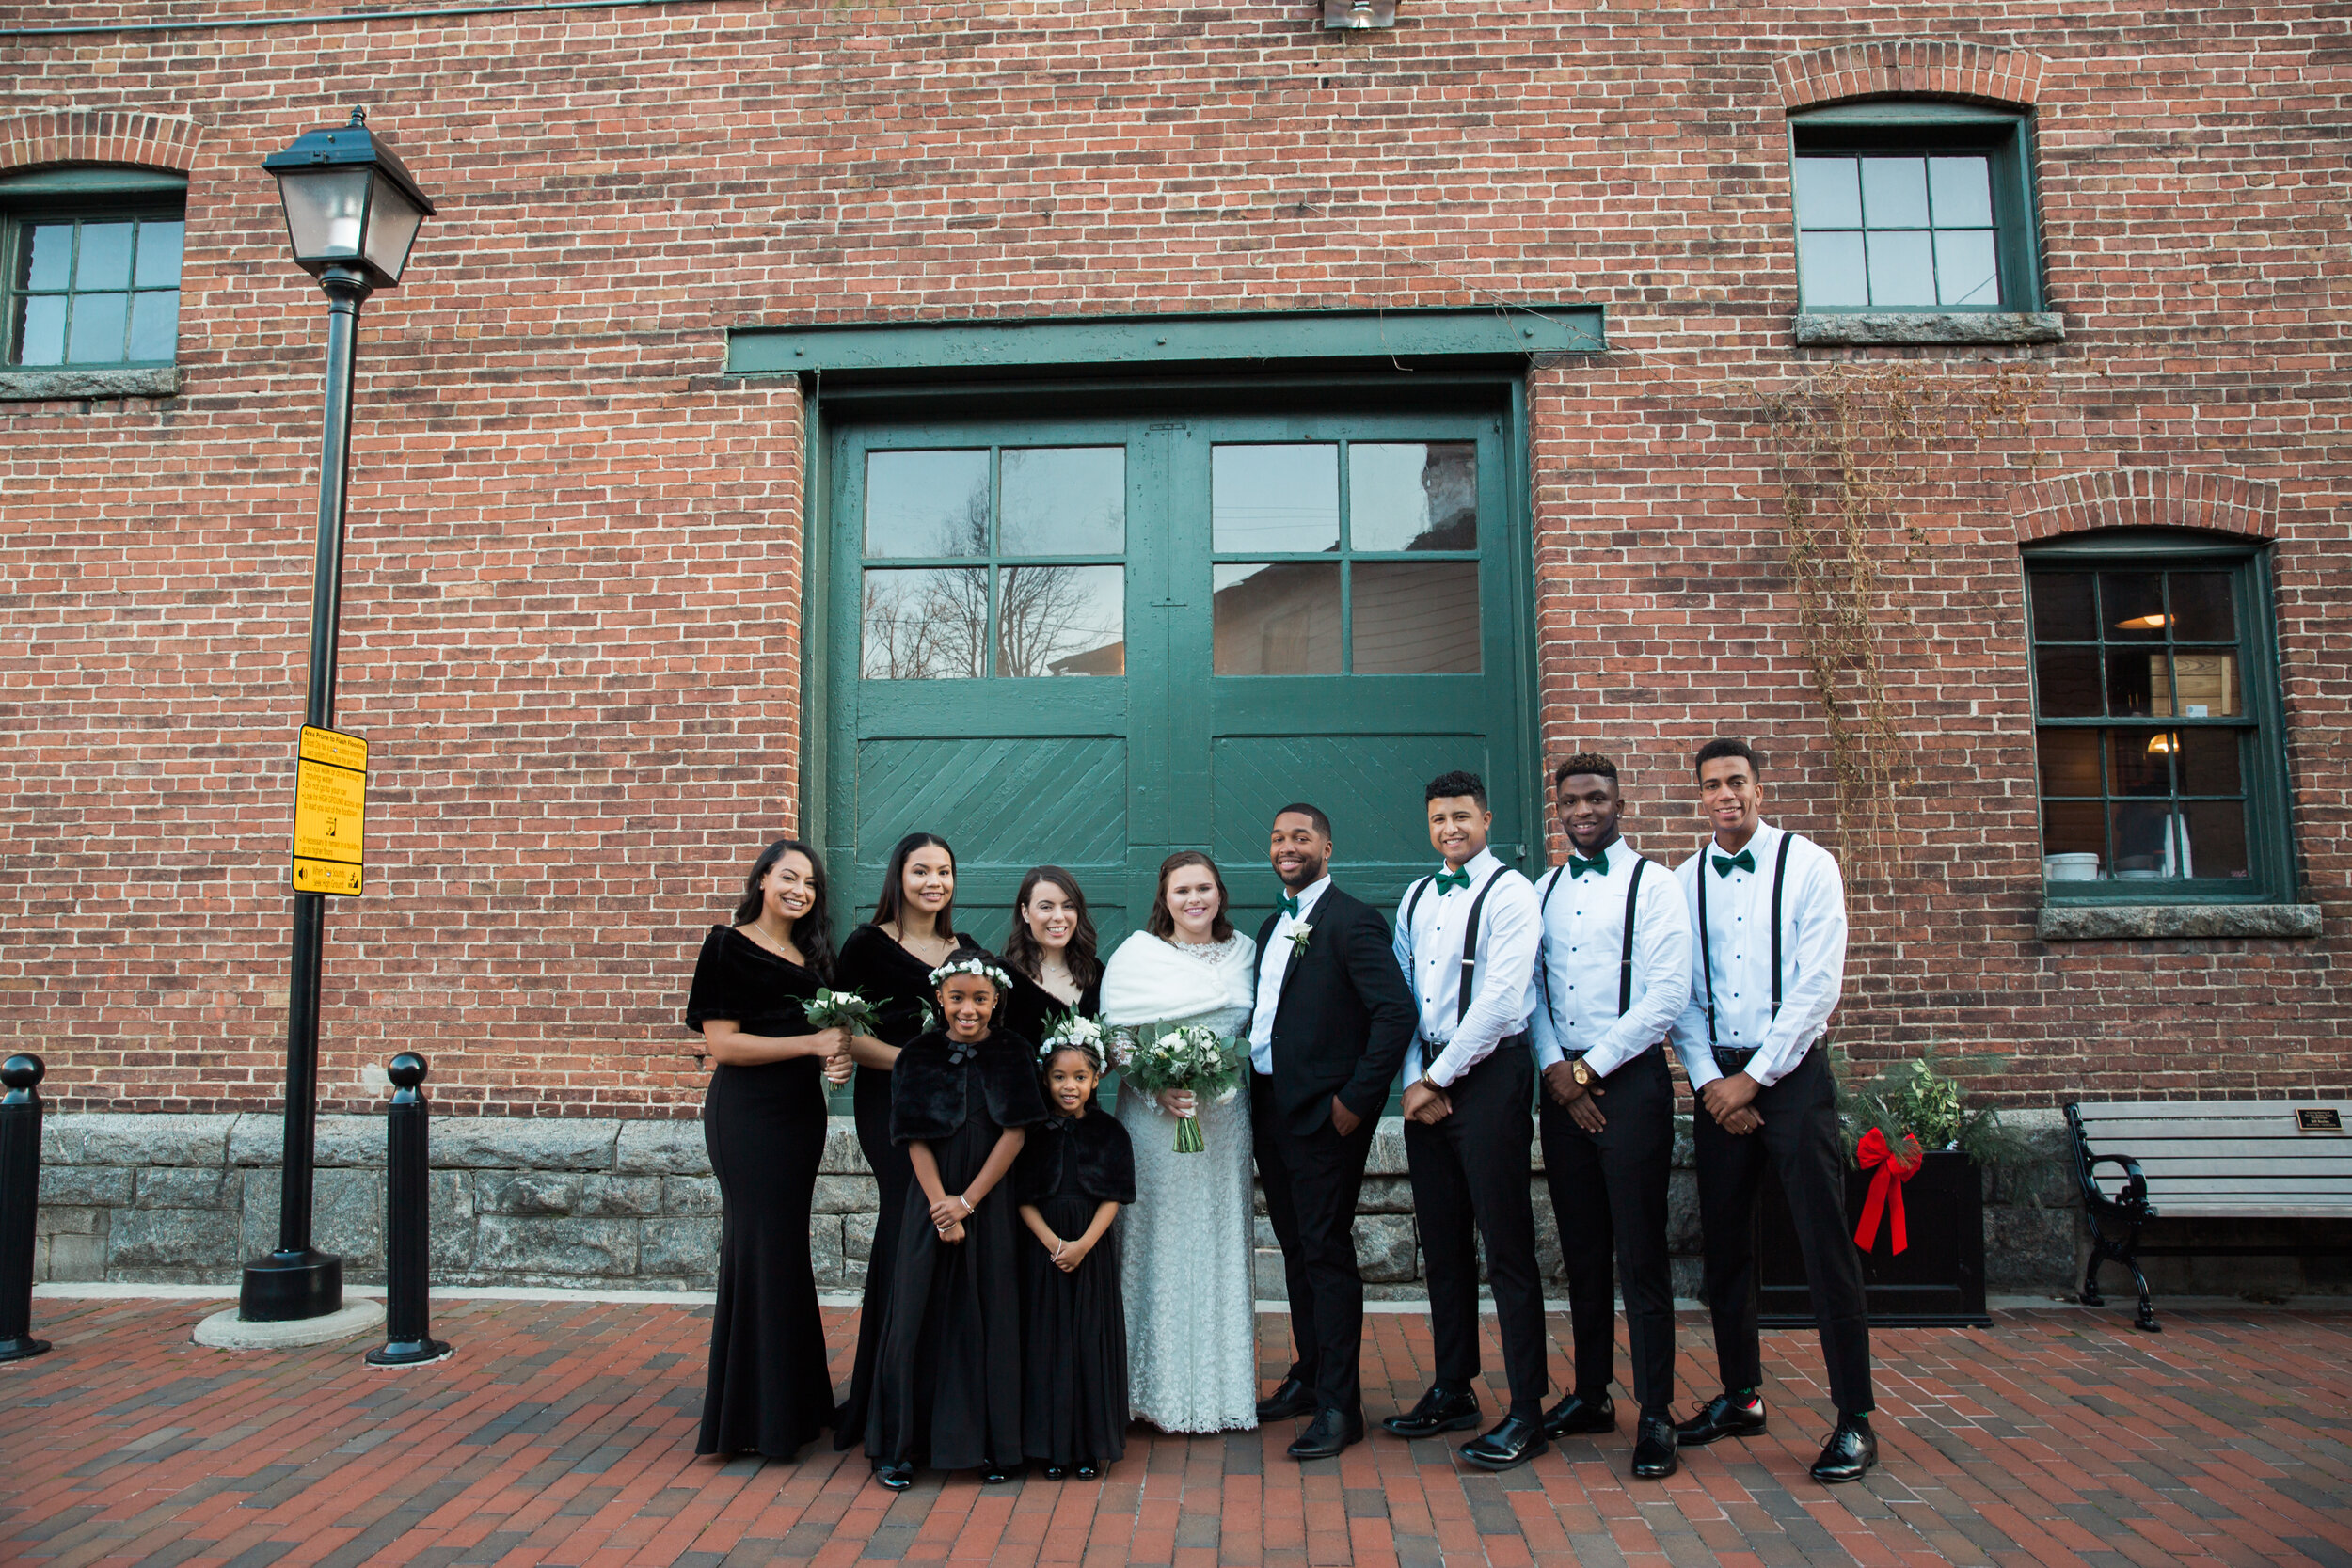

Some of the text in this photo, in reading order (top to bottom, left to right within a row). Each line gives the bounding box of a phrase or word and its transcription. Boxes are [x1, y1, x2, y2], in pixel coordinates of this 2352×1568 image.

[316, 732, 328, 740] Prone
[336, 736, 346, 745] Flash
[347, 740, 366, 752] Flooding
[305, 772, 321, 783] moving
[306, 763, 312, 771] Do
[336, 770, 345, 779] drive
[346, 772, 361, 783] through
[305, 781, 312, 789] Do
[330, 787, 340, 796] your
[304, 791, 312, 800] Look
[319, 794, 328, 802] HIGH
[328, 795, 344, 806] GROUND
[343, 800, 355, 808] access
[306, 838, 324, 849] necessary
[301, 847, 308, 855] go
[312, 847, 324, 856] higher
[312, 865, 324, 876] When
[313, 878, 344, 890] Seek High Ground
